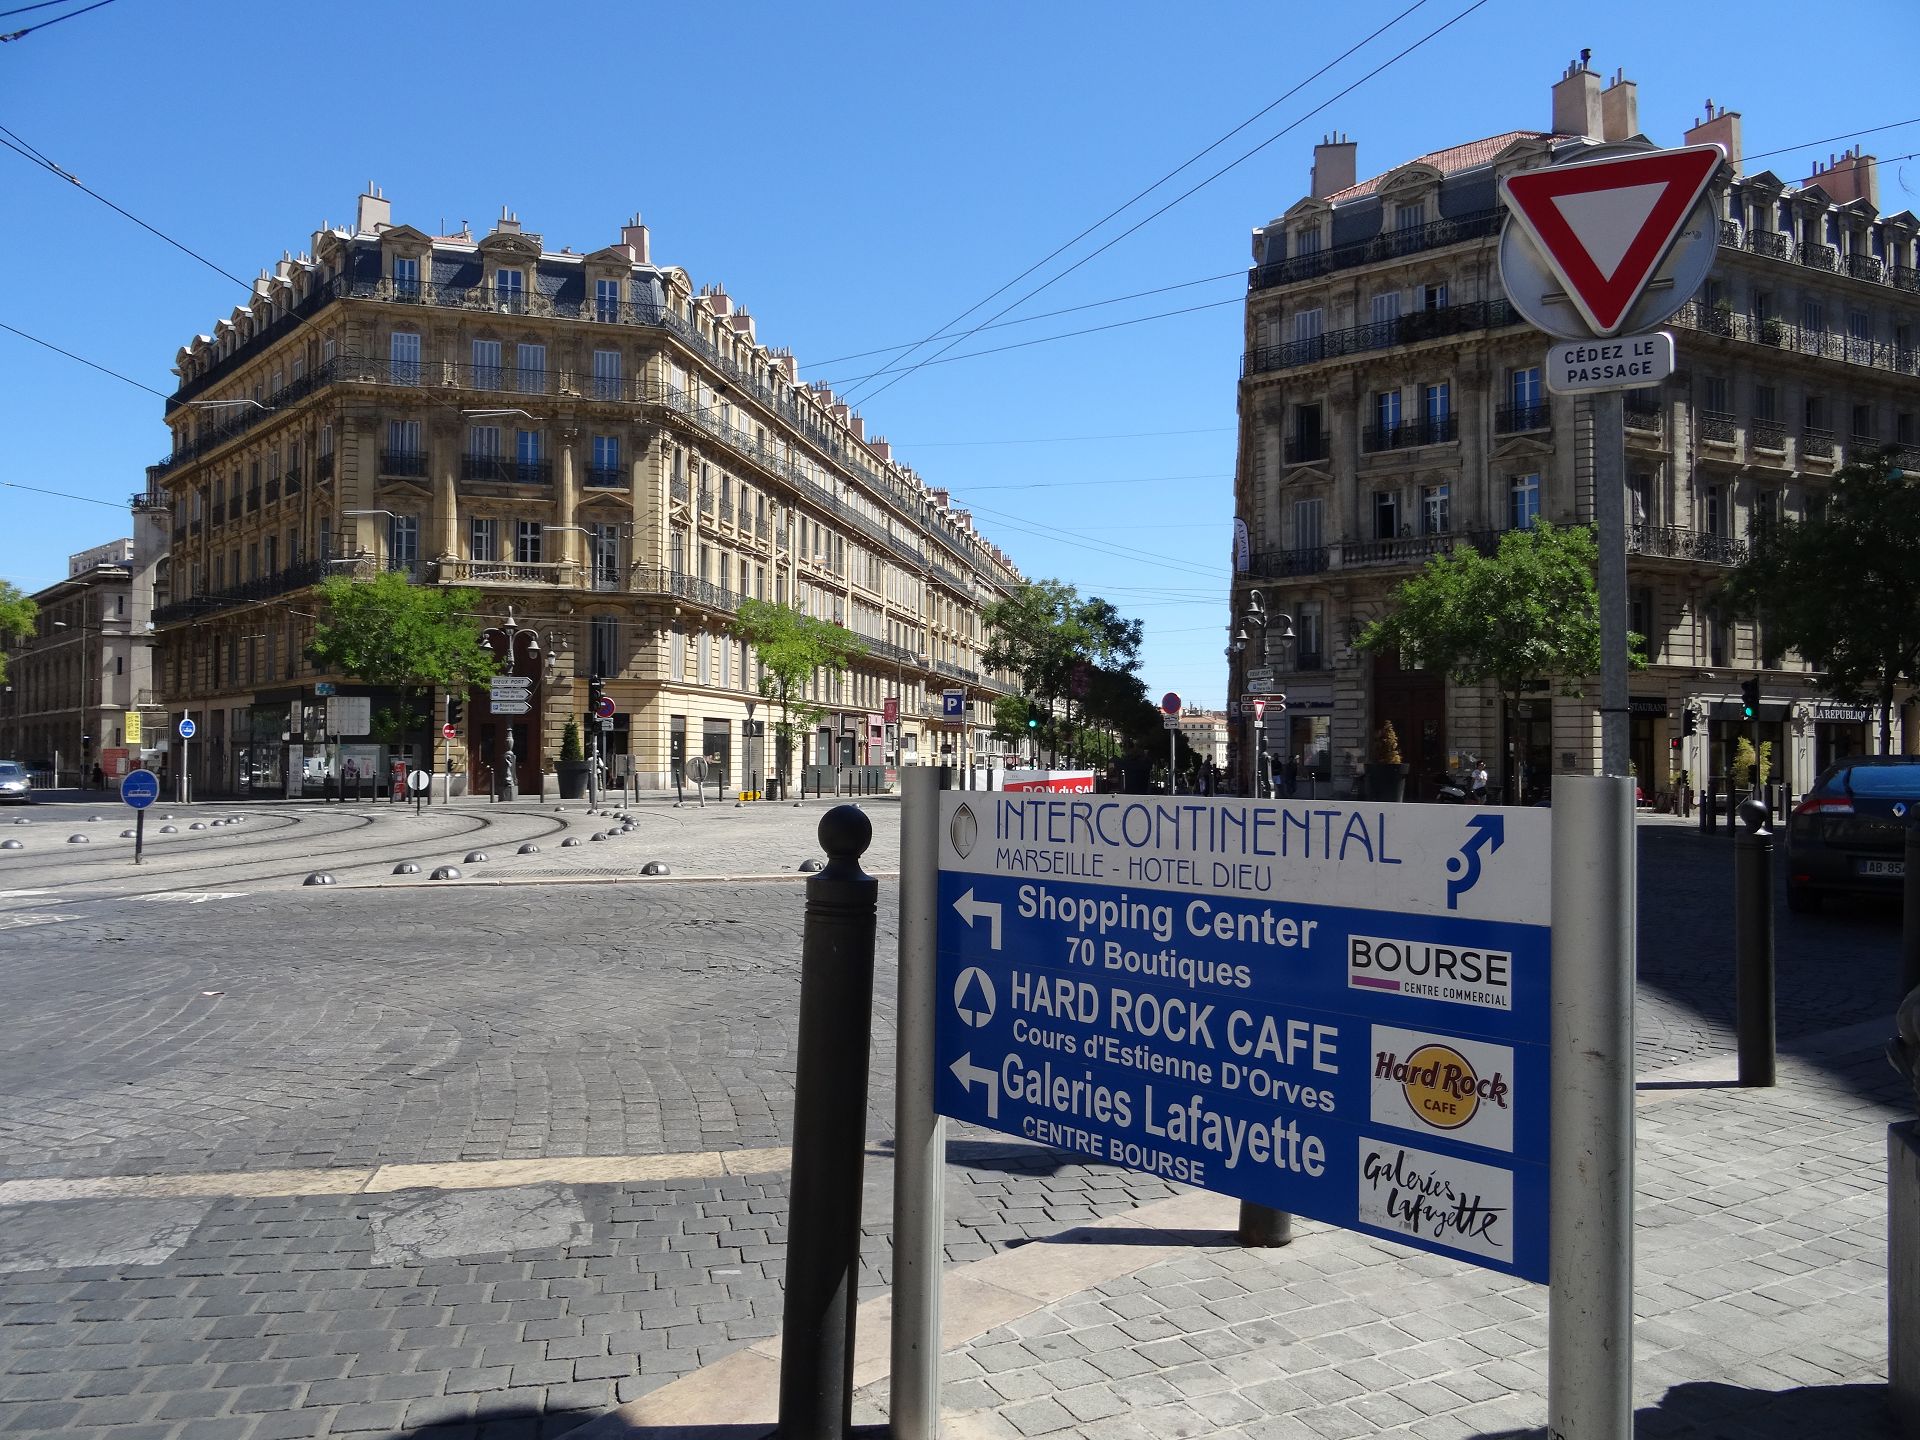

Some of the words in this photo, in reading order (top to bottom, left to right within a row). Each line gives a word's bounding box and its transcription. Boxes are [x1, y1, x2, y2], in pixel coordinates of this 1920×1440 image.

[1564, 346, 1623, 364] CÉDEZ
[1634, 341, 1655, 356] LE
[1567, 361, 1652, 383] PASSAGE
[947, 698, 958, 711] P
[1630, 702, 1669, 714] STAURANT
[1075, 785, 1094, 793] SA
[995, 799, 1403, 865] INTERCONTINENTAL
[995, 847, 1105, 878] MARSEILLE
[1129, 856, 1203, 886] HOTEL
[1213, 862, 1273, 892] DIEU
[1018, 884, 1173, 942] Shopping
[1185, 900, 1318, 950] Center
[1065, 937, 1095, 966] 70
[1104, 941, 1252, 989] Boutiques
[1351, 938, 1508, 987] BOURSE
[1404, 982, 1439, 997] CENTRE
[1443, 987, 1507, 1006] COMMERCIAL
[1011, 970, 1099, 1024] HARD
[1110, 987, 1215, 1050] ROCK
[1227, 1009, 1339, 1075] CAFE
[1012, 1018, 1077, 1054] Cours
[1083, 1034, 1213, 1085] d'Estienne
[1221, 1062, 1336, 1113] D'Orves
[1374, 1051, 1442, 1090] Hard
[1442, 1063, 1508, 1110] Rock
[1002, 1052, 1132, 1129] Galeries
[1144, 1084, 1326, 1178] Lafayette
[1423, 1098, 1457, 1116] CAFE
[1022, 1115, 1104, 1157] CENTRE
[1110, 1137, 1206, 1186] BOURSE
[1363, 1149, 1456, 1201] Galeries
[1386, 1187, 1508, 1247] Lafayette
